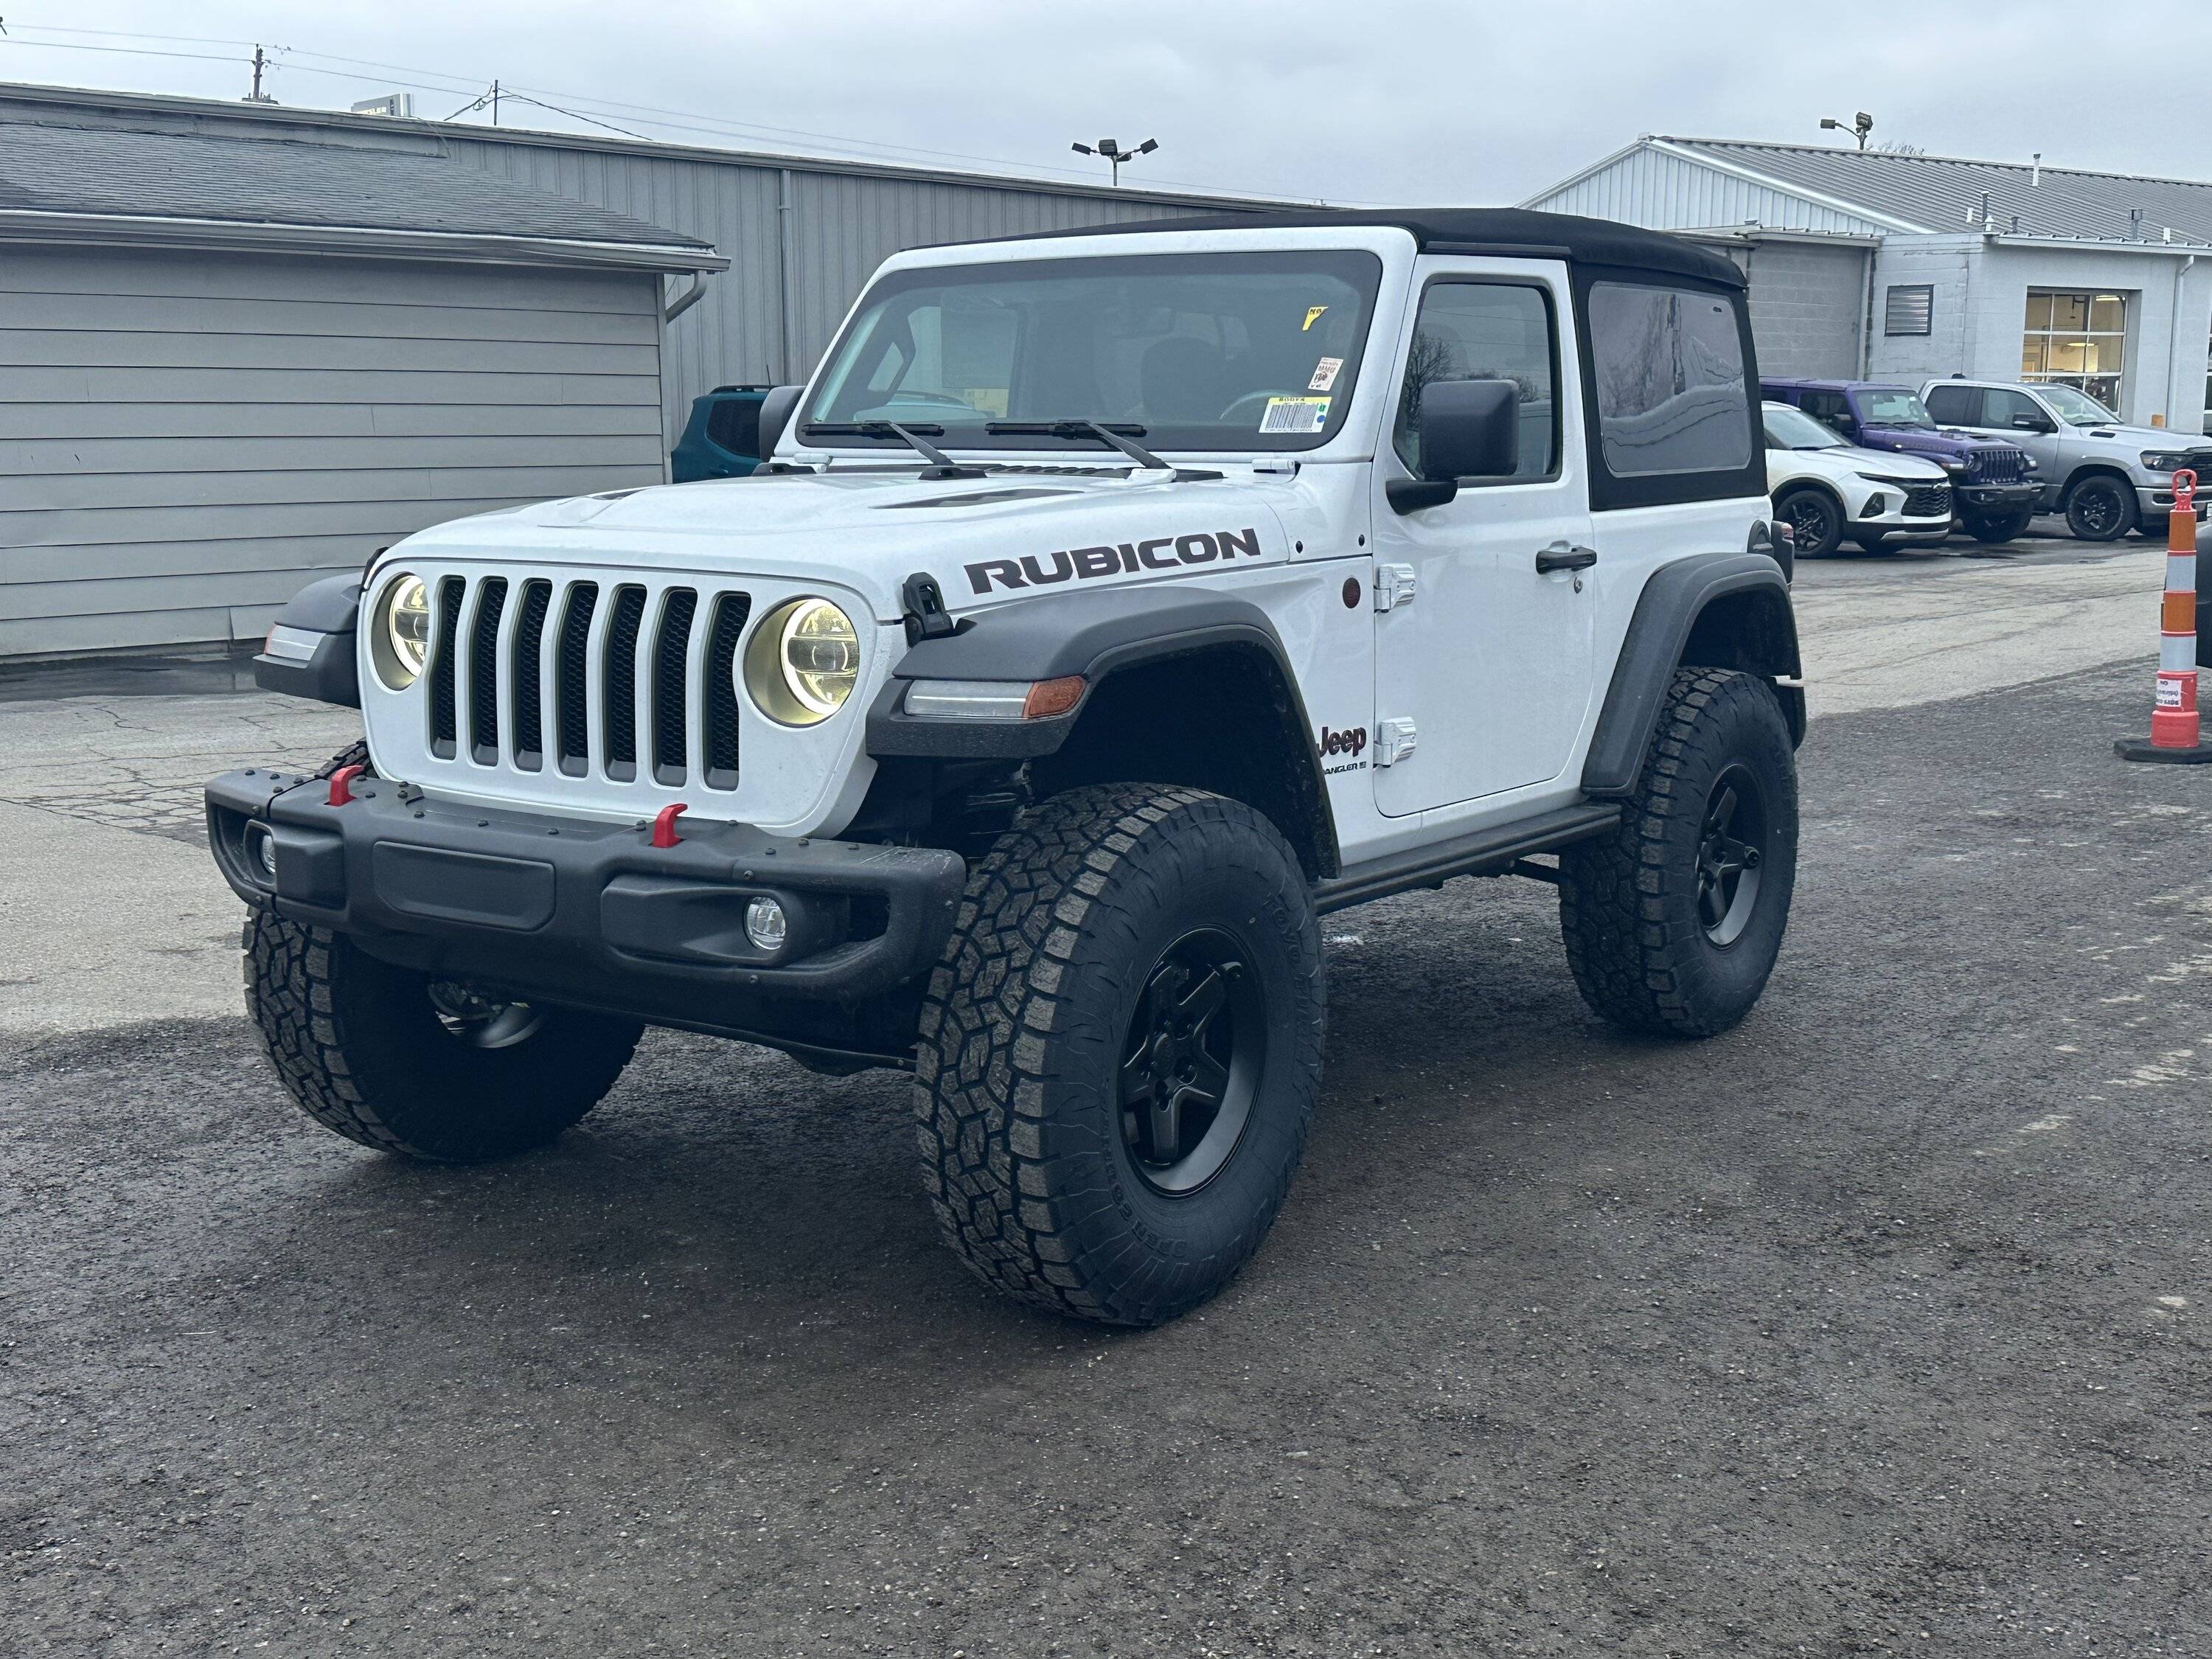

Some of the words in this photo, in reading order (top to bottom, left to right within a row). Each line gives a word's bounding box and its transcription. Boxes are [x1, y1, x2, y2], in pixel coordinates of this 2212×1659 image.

[964, 528, 1261, 594] RUBICON
[1316, 726, 1366, 757] Jeep
[1324, 762, 1358, 775] ANGLER
